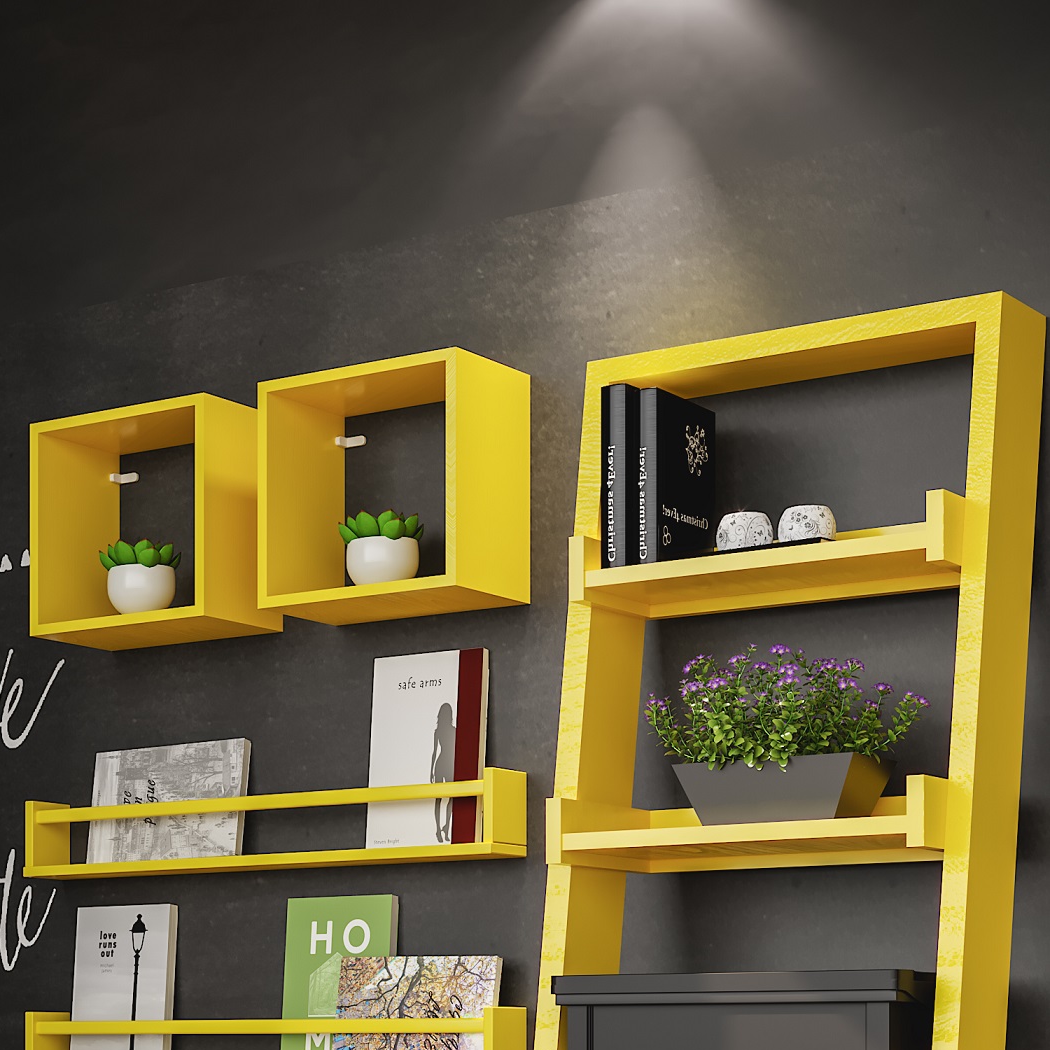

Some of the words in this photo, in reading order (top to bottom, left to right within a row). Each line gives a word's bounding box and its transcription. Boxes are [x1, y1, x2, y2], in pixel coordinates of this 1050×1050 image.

[398, 676, 417, 690] safe
[419, 677, 443, 689] arms
[99, 930, 117, 940] love
[310, 918, 371, 955] HO
[98, 941, 117, 949] runs
[100, 949, 114, 958] out
